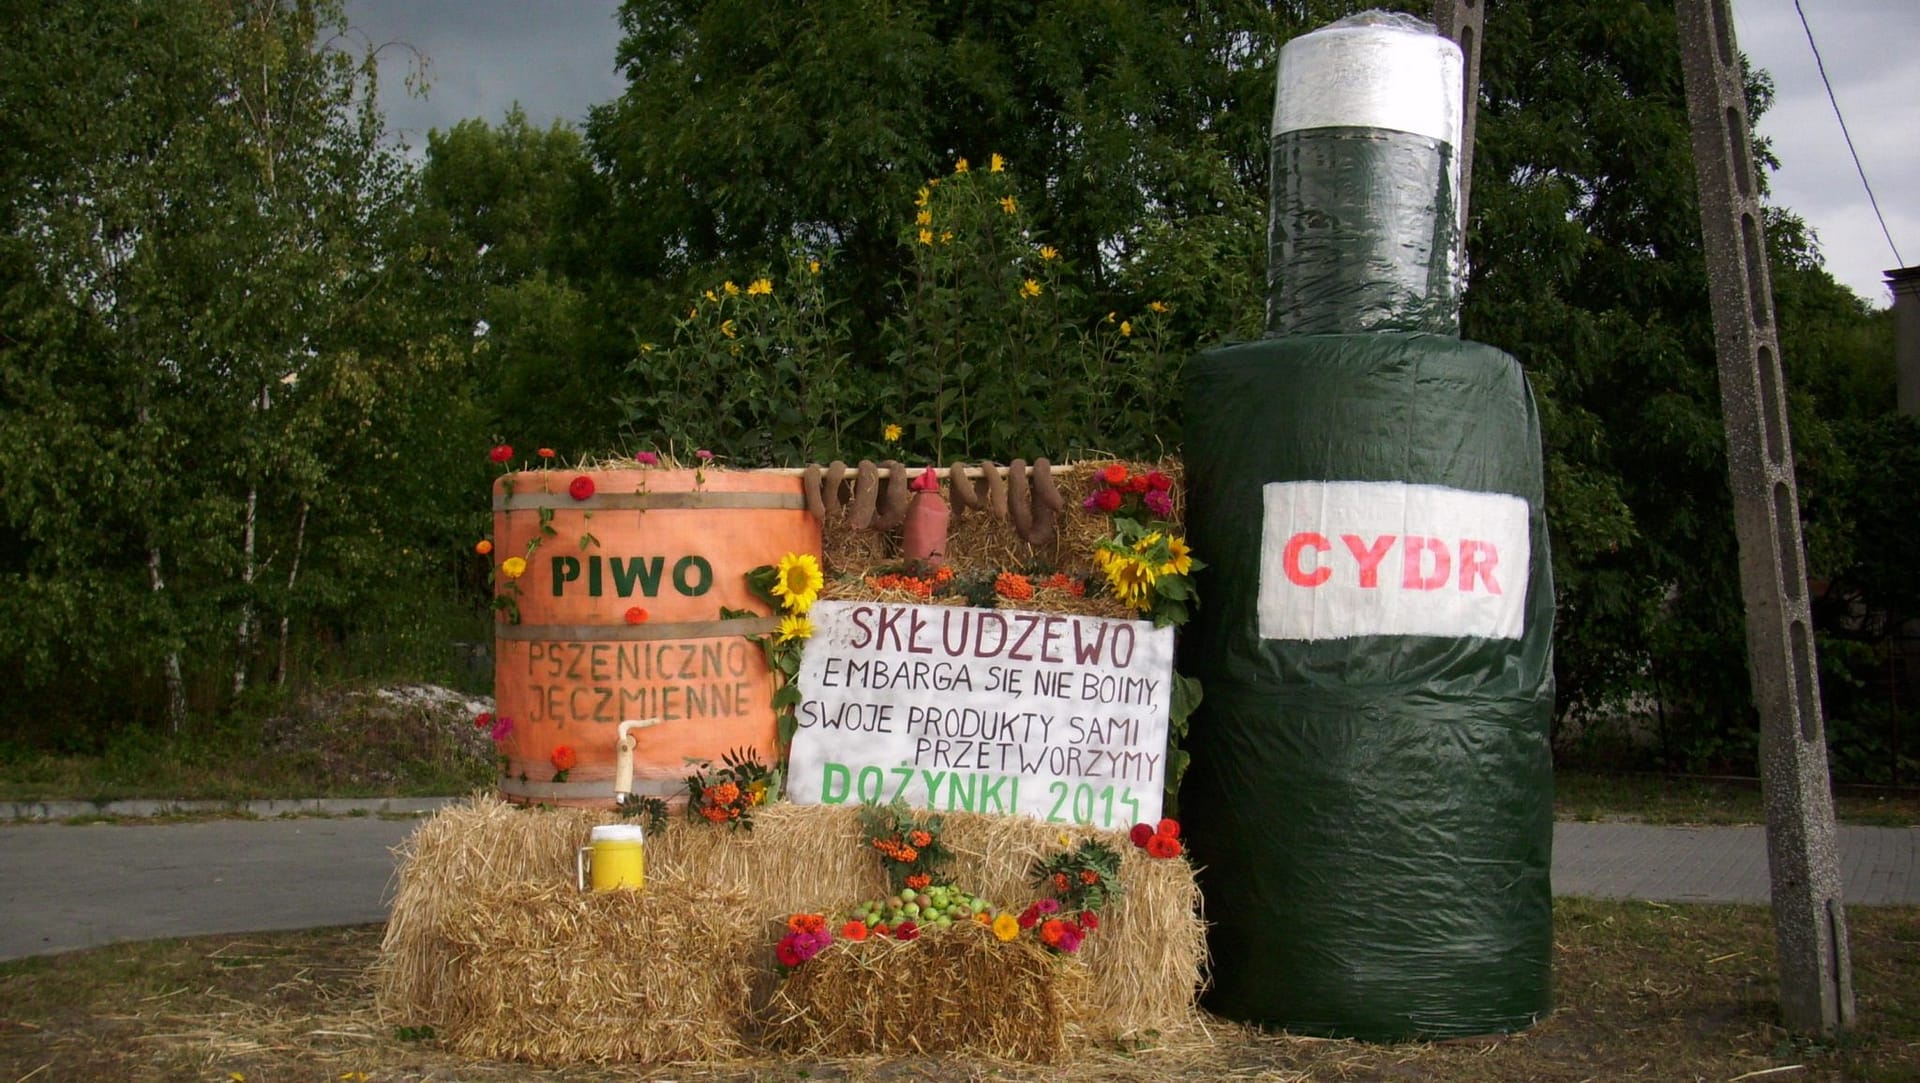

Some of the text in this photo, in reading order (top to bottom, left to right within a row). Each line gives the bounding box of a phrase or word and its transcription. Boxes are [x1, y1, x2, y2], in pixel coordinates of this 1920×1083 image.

[551, 555, 713, 597] PIWO
[1282, 531, 1502, 595] CYDR
[851, 607, 1135, 668] SKŁUDZEWO
[528, 641, 748, 681] PSZENICZNO
[529, 682, 751, 728] JĘCZMIENNE
[822, 657, 1159, 713] EMBARGA SIĘ NIE BOIMY,
[799, 701, 1139, 745] SWOJE PRODUKTY SAMI
[914, 738, 1160, 782] PRZETWORZYMY
[821, 760, 1018, 815] DOŻYNKI
